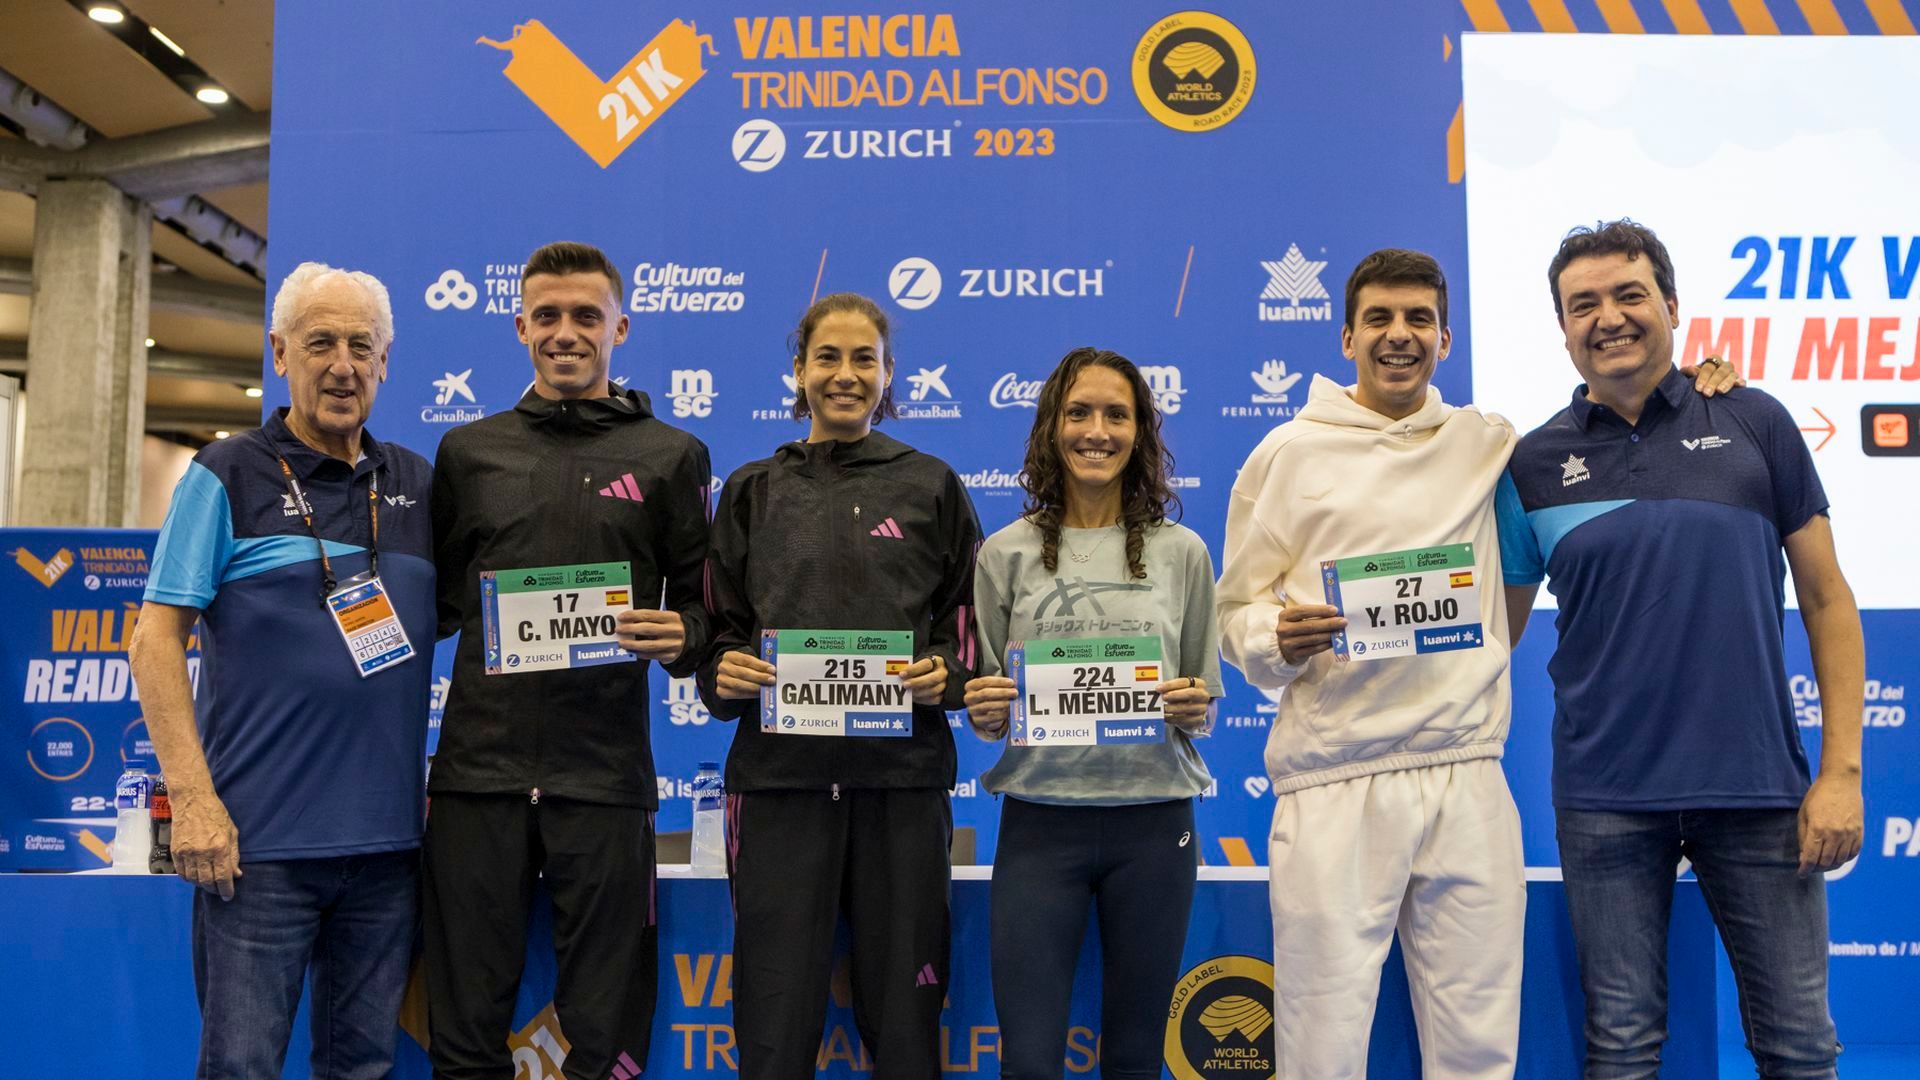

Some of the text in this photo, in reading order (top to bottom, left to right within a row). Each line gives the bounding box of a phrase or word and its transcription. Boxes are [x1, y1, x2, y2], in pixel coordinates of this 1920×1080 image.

[734, 13, 960, 59] VALENCIA
[1138, 18, 1184, 62] GOLD LABEL
[732, 66, 1108, 109] TRINIDAD ALFONSO
[1175, 82, 1214, 92] WORLD
[598, 48, 684, 142] 21K
[1167, 92, 1222, 101] ATHLETICS
[1193, 69, 1252, 127] ROAD RACE 2023
[803, 128, 952, 159] ZURICH
[973, 127, 1055, 157] 2023
[633, 262, 744, 287] Cultura del
[1725, 236, 1857, 300] 21K
[958, 268, 1104, 298] ZURICH
[630, 287, 745, 313] Esfuerzo
[1258, 302, 1332, 321] luanvi
[1680, 317, 1770, 381] MI
[420, 408, 485, 423] CaixaBank
[752, 410, 791, 420] FERIA
[897, 405, 962, 419] CaixaBank
[1221, 406, 1263, 417] FERIA
[1562, 471, 1591, 487] luanvi
[79, 547, 147, 561] VALENCIA
[43, 556, 69, 581] 21K
[82, 562, 135, 575] TRINIDAD
[105, 577, 149, 588] ZURICH
[1395, 577, 1422, 599] 27
[553, 593, 579, 613] 17
[1365, 598, 1458, 628] Y. ROJO
[518, 620, 541, 642] C.
[549, 614, 616, 640] MAYO
[856, 642, 888, 650] Esfuerzo
[1371, 639, 1409, 651] ZURICH
[1423, 632, 1460, 645] luanvi
[525, 653, 563, 663] ZURICH
[577, 648, 614, 660] luanvi
[824, 658, 866, 679] 215
[1073, 666, 1116, 687] 224
[781, 683, 907, 706] GALIMANY
[1881, 685, 1904, 700] del
[1029, 694, 1050, 716] L.
[1058, 687, 1161, 715] MÉNDEZ
[800, 719, 838, 728] ZURICH
[853, 719, 890, 729] luanvi
[1226, 716, 1267, 728] FERIA
[1051, 729, 1089, 737] ZURICH
[1104, 726, 1142, 737] luanvi
[25, 842, 66, 851] Esfuerzo
[1169, 964, 1224, 1019] GOLD LABEL
[1213, 1047, 1259, 1058] WORLD
[1203, 1059, 1270, 1070] ATHLETICS
